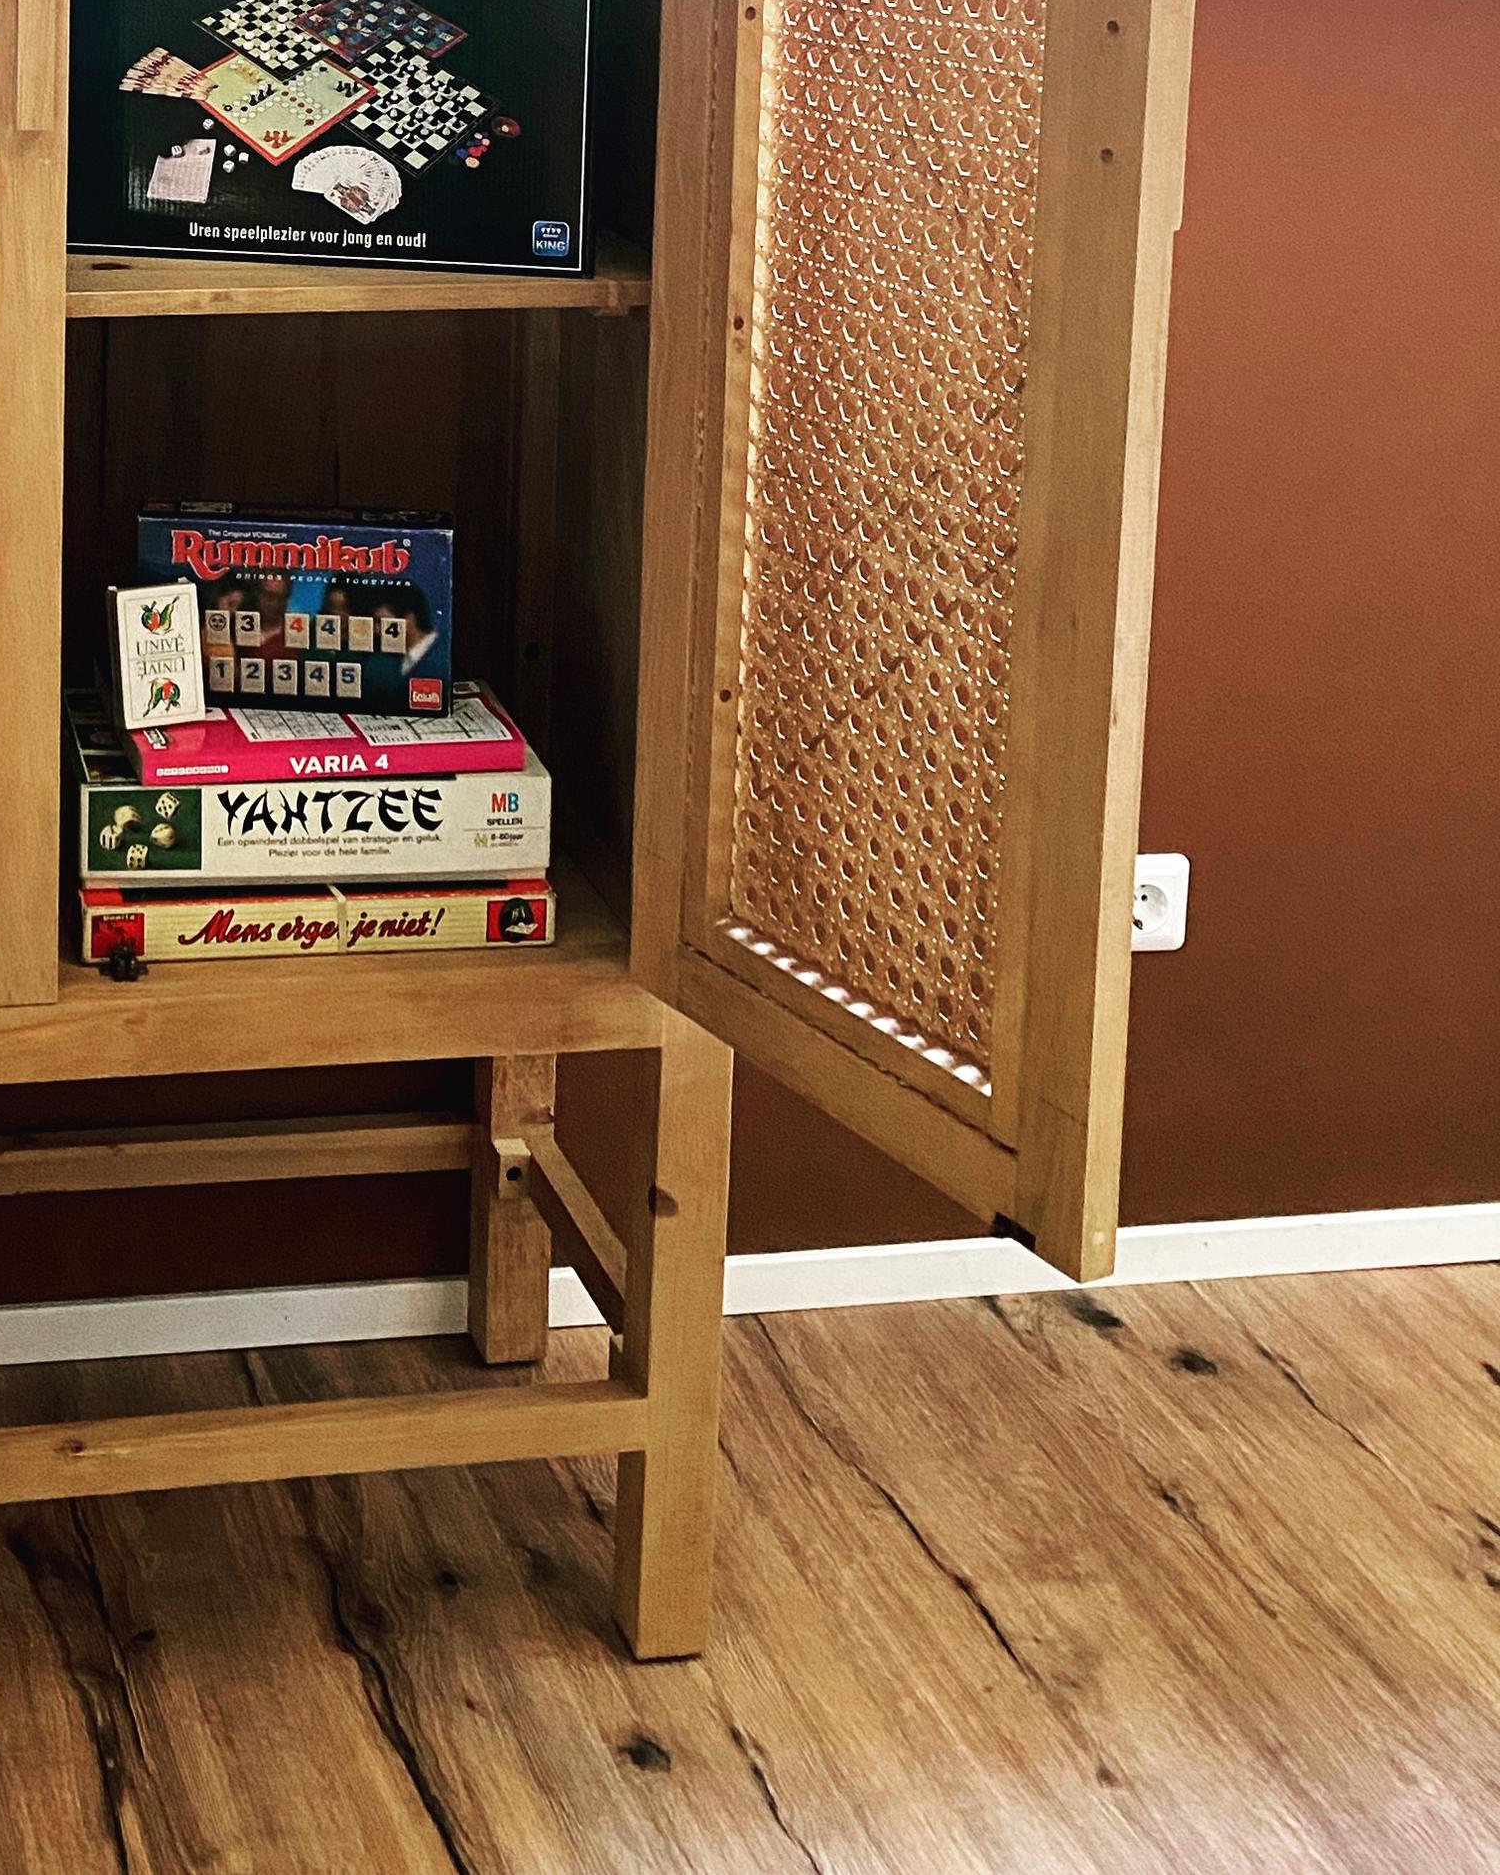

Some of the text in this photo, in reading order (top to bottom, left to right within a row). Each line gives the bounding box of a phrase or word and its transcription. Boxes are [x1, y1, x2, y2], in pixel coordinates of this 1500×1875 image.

[189, 222, 427, 248] Uren speelplezier voor jong en oud!
[536, 240, 566, 251] KING
[171, 528, 411, 581] Rummikub
[240, 615, 255, 632] 3
[289, 617, 304, 633] 4
[320, 619, 336, 635] 4
[384, 622, 399, 638] 4
[136, 634, 186, 657] UNIVÉ
[215, 663, 355, 684] 1 2 3 4 5
[289, 753, 389, 775] VARIA 4
[216, 786, 444, 836] YAHTZEE
[491, 792, 519, 813] MB
[486, 817, 523, 826] SPELLEN
[178, 907, 446, 949] Mens erge je niet!
